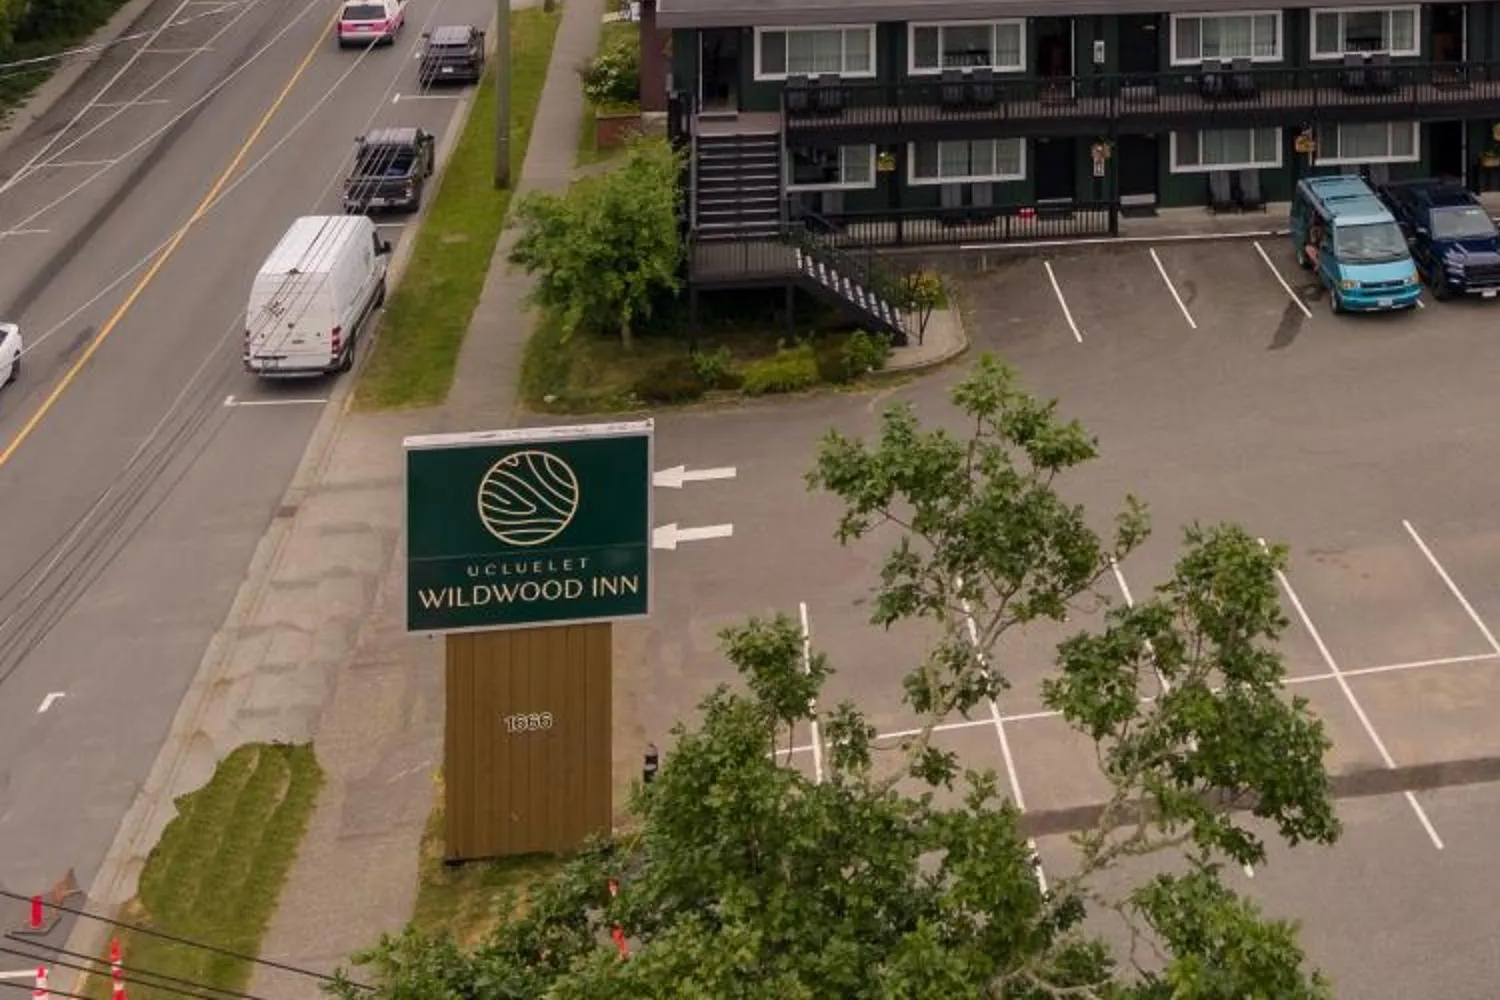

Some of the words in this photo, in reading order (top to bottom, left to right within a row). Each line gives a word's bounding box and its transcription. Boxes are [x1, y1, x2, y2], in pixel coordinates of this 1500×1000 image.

[467, 557, 590, 577] UCLUELET
[418, 579, 583, 609] WILDWOOD
[592, 575, 639, 598] INN
